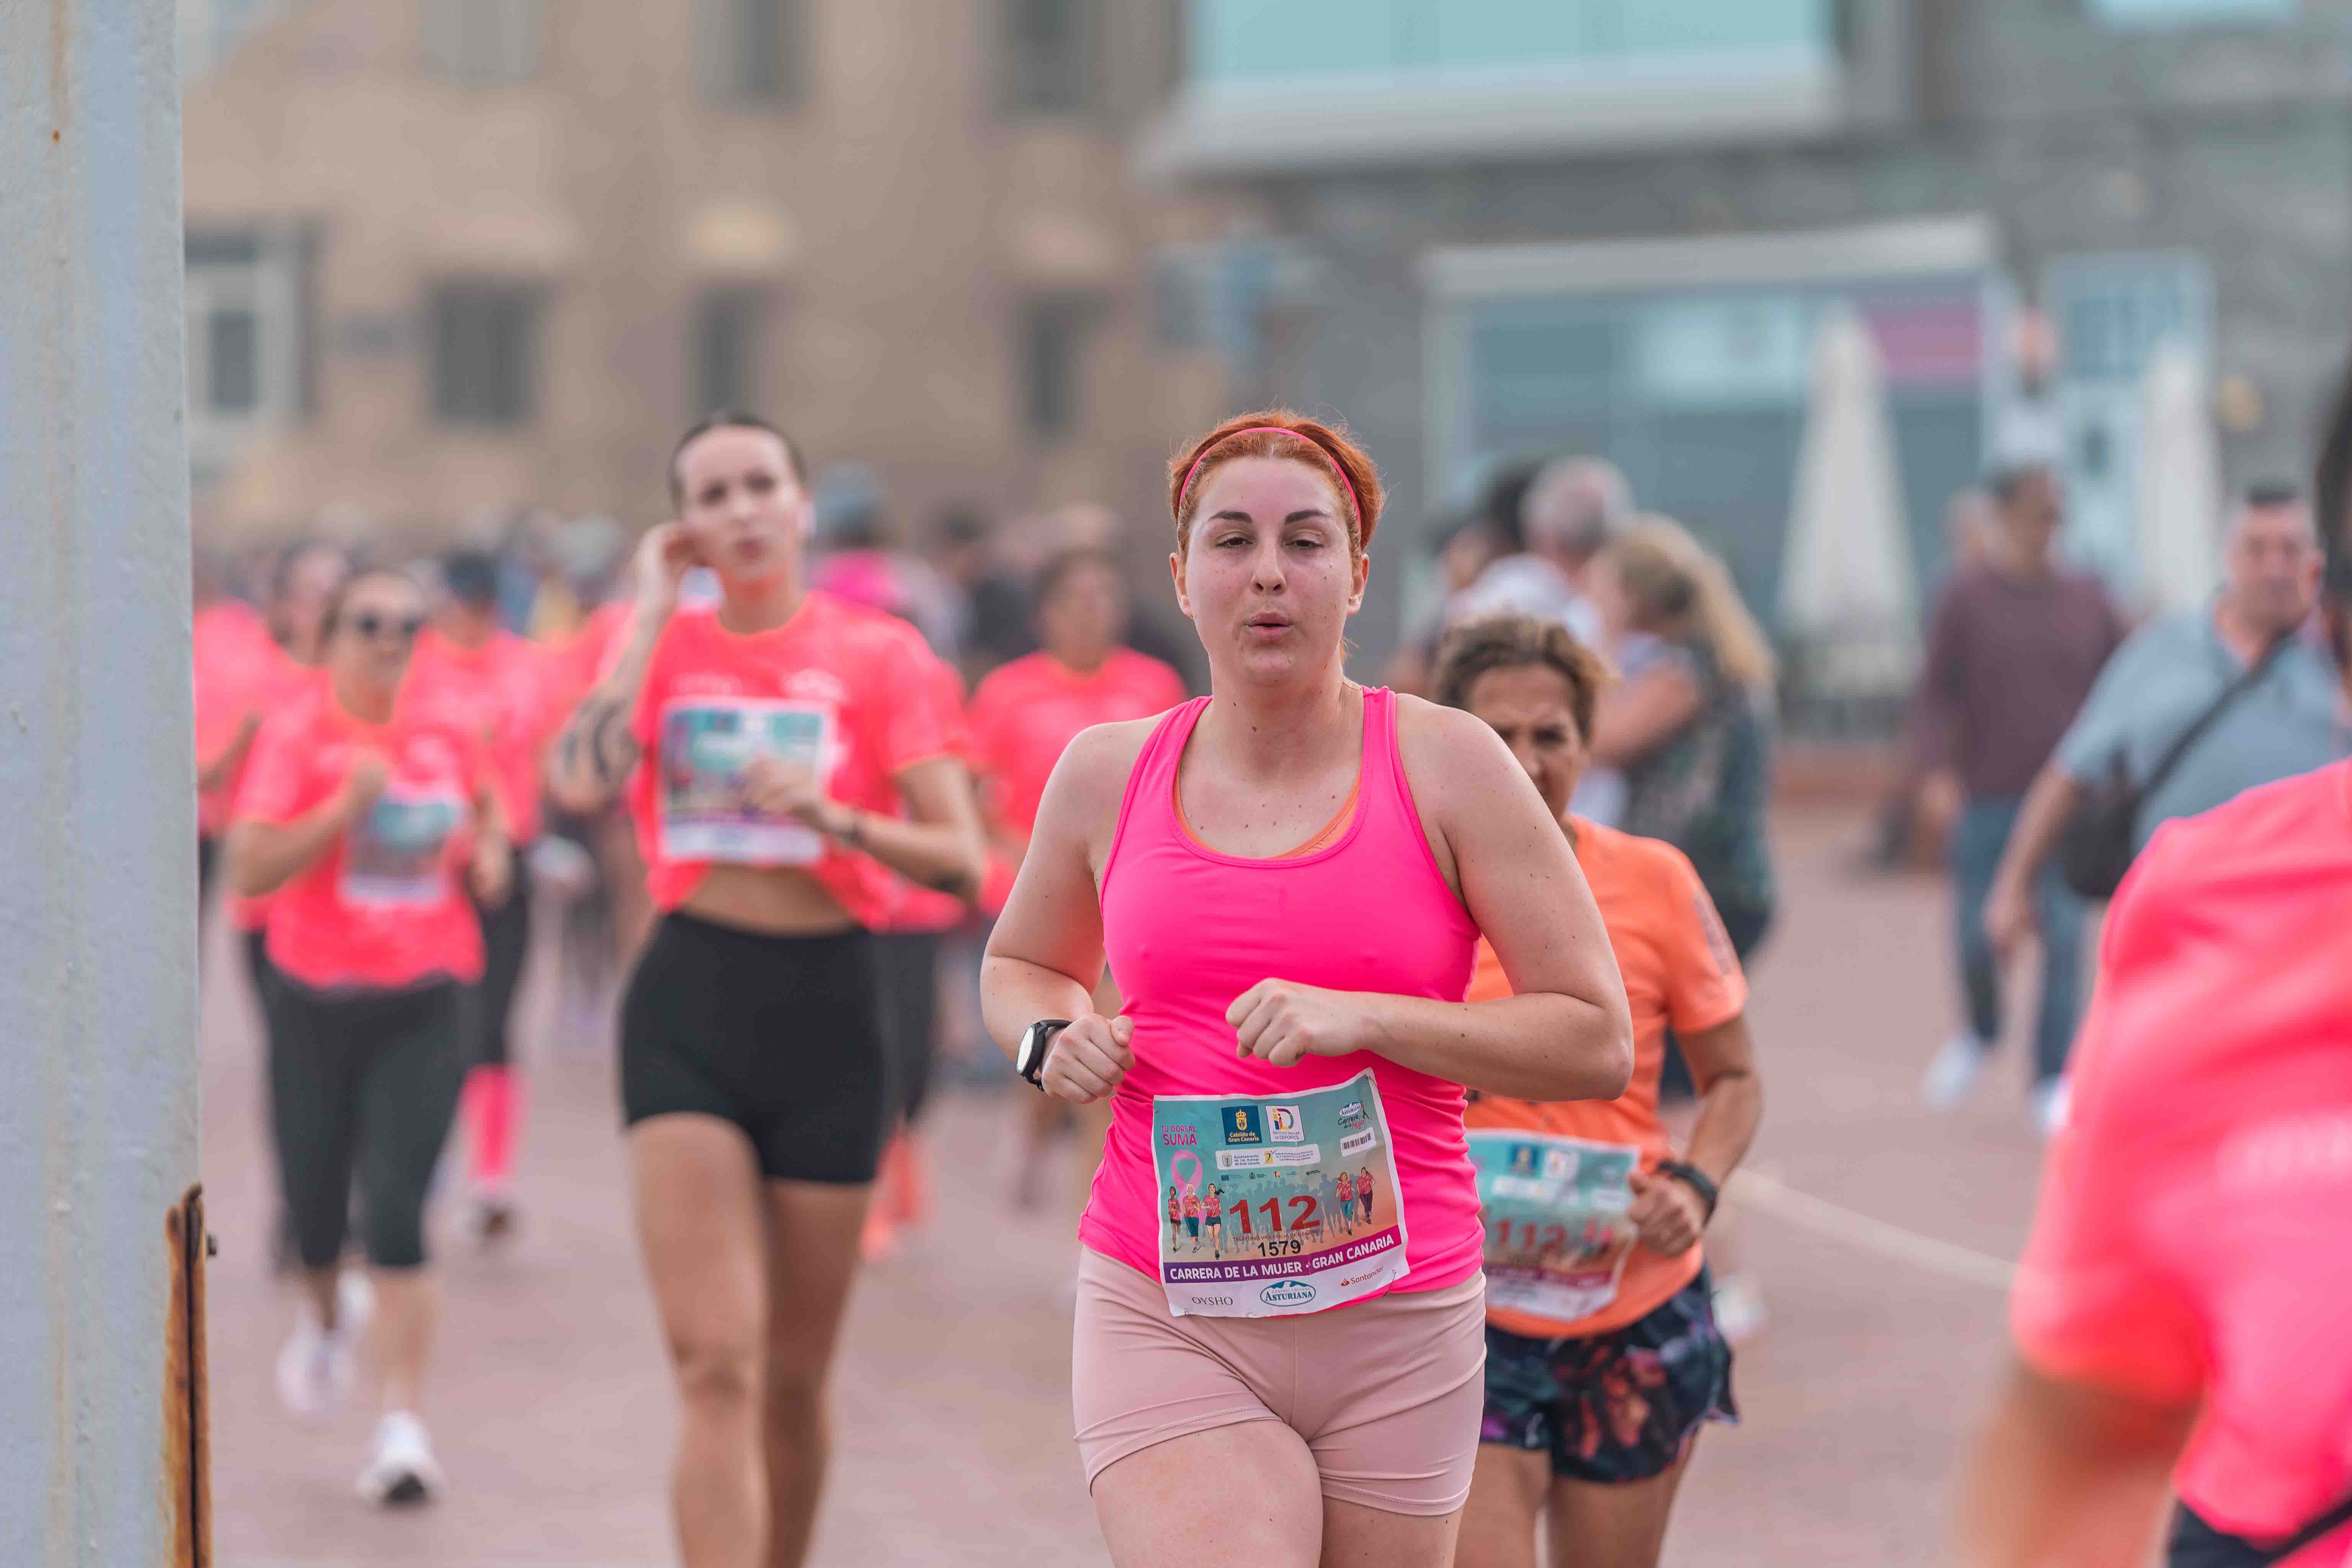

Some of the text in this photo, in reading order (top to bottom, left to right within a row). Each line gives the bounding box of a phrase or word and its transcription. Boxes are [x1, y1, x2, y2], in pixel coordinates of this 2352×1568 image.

[1163, 1133, 1197, 1145] SUMA
[1230, 1195, 1320, 1234] 112
[1170, 1234, 1394, 1280] CARRERA DE LA MUJER GRAN CANARIA
[1258, 1239, 1301, 1257] 1579
[1350, 1265, 1384, 1285] Santander
[1192, 1296, 1233, 1306] OYSHO
[1265, 1291, 1312, 1302] ASTURIANA
